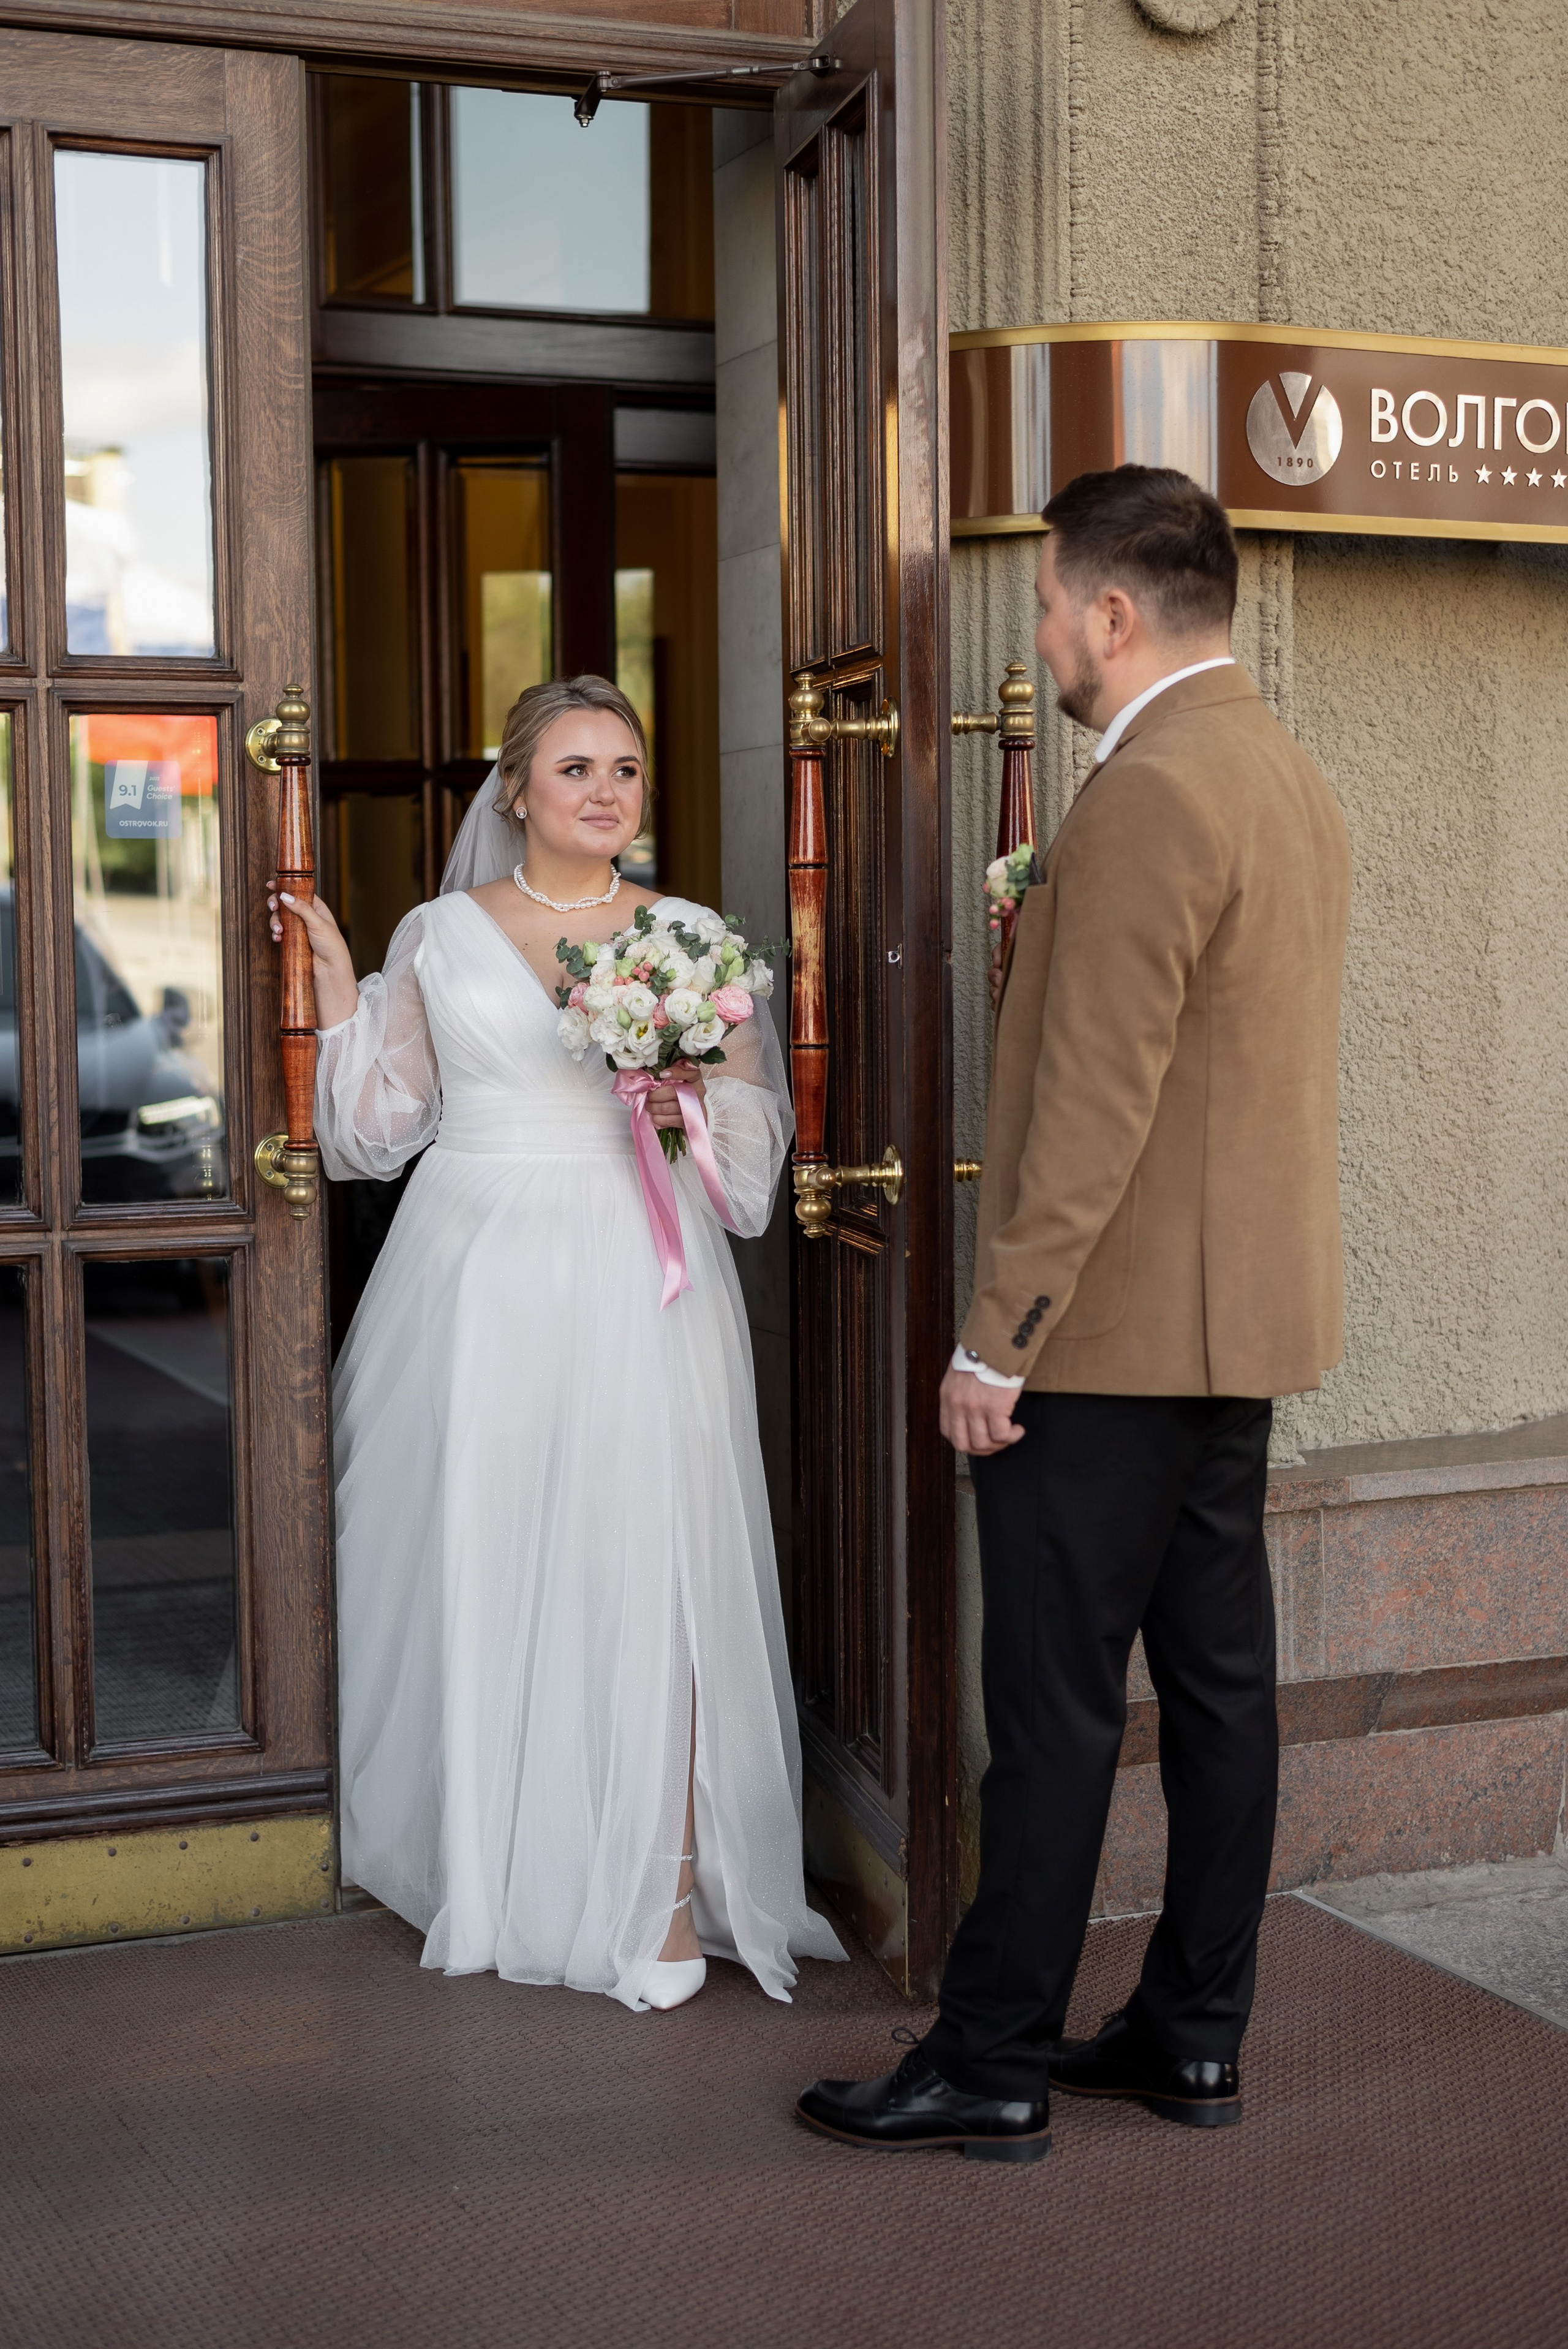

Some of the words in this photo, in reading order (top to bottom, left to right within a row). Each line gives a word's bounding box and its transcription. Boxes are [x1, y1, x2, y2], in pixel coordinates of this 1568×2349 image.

[1370, 387, 1568, 455] ВОЛГО
[1276, 456, 1314, 469] 1890
[1370, 460, 1459, 483] ОТЕЛЬ
[119, 785, 136, 796] 9.1
